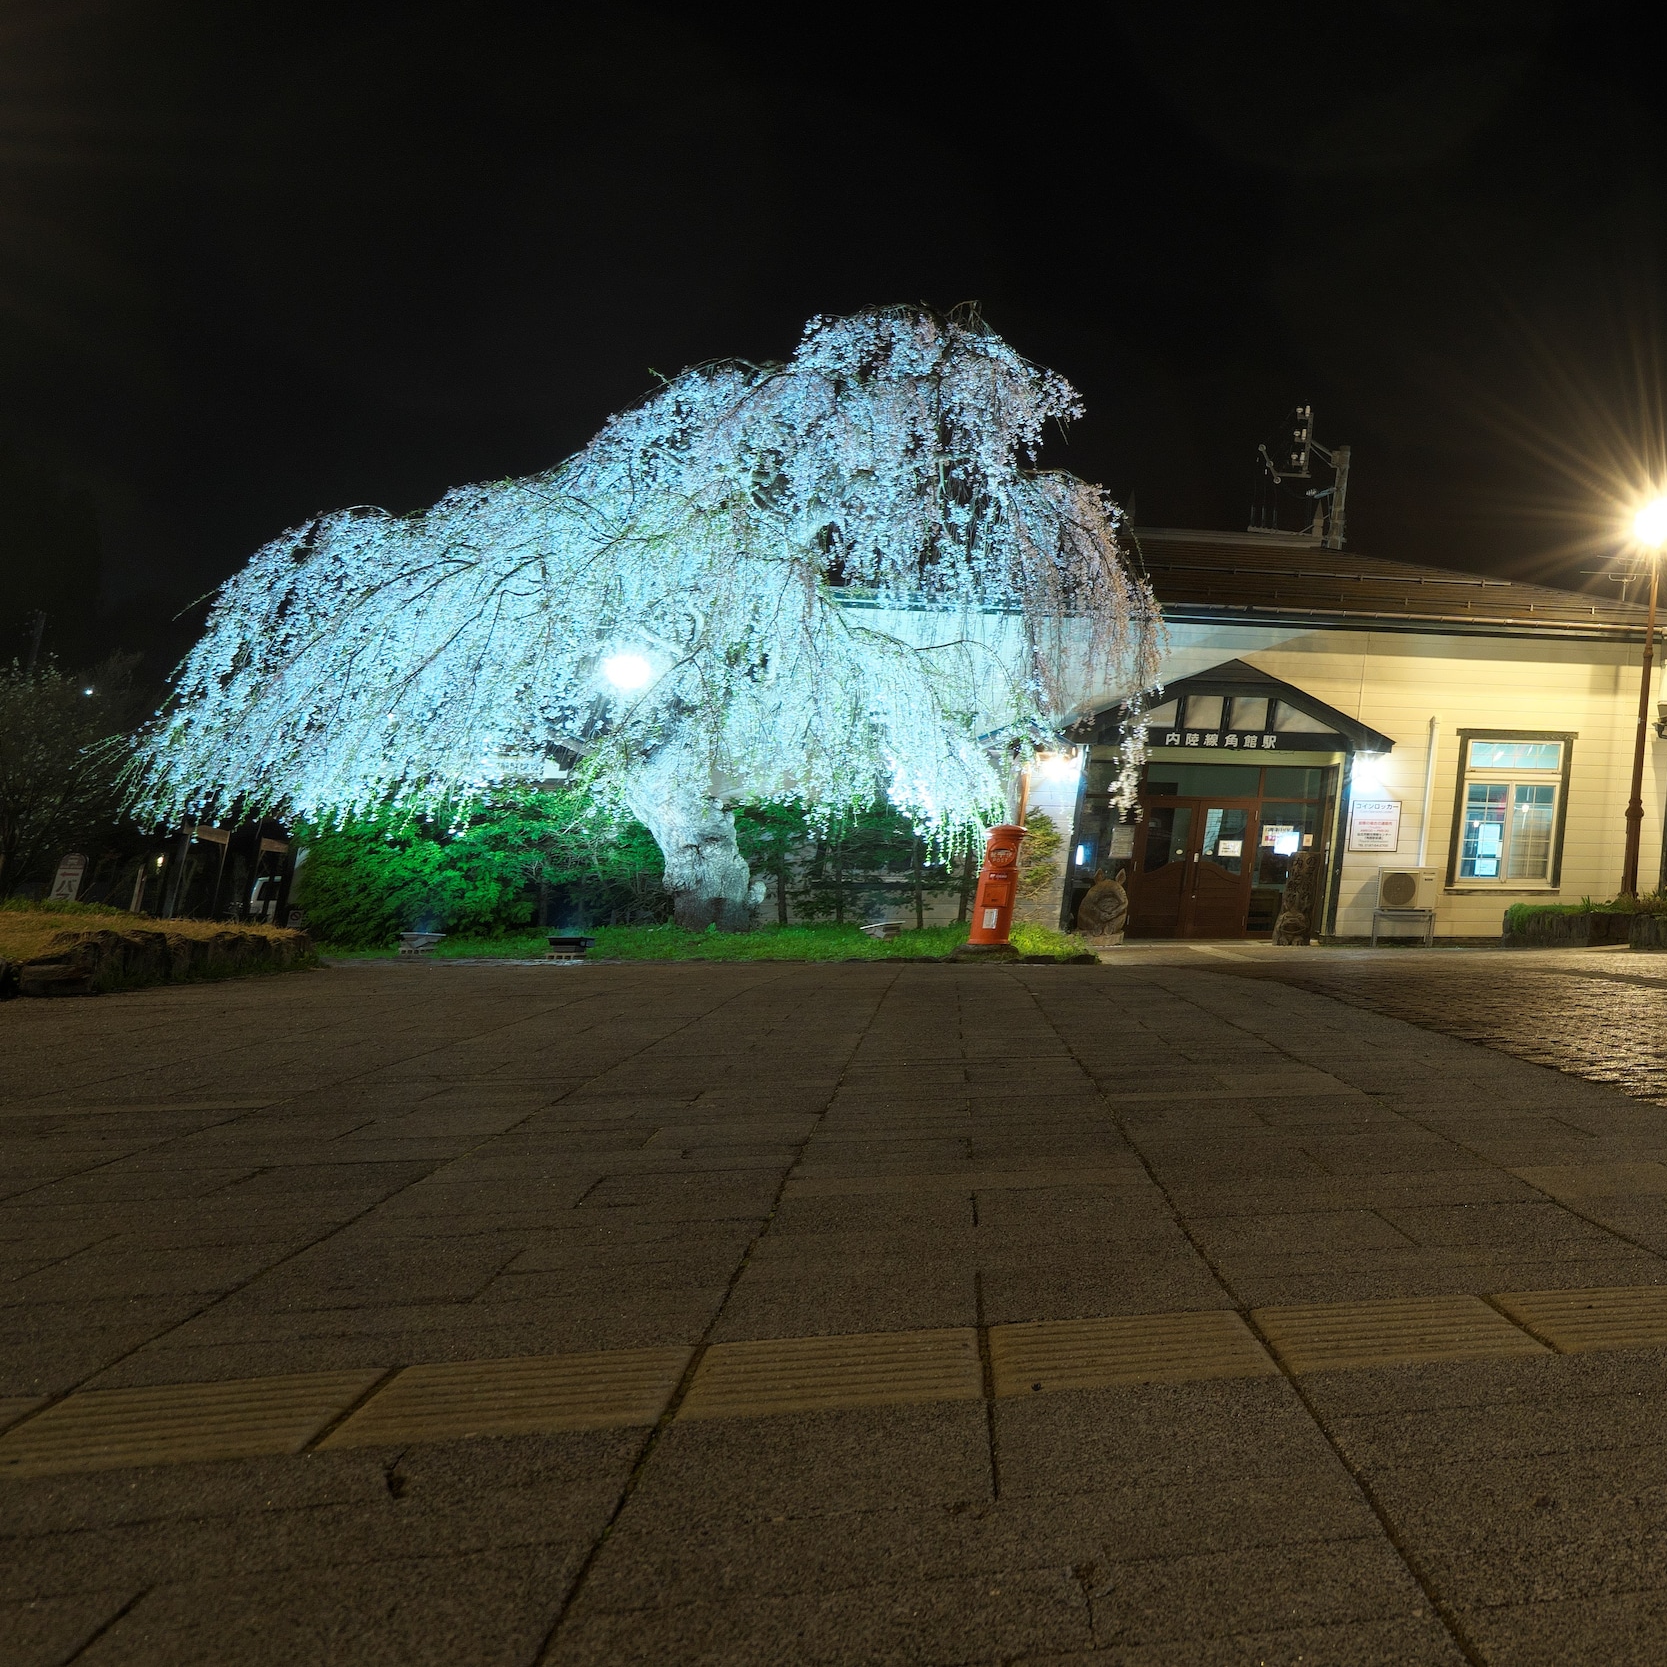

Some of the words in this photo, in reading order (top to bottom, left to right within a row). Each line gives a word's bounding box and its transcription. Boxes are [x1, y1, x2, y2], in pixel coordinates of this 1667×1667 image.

[1165, 733, 1277, 749] 内陸線角館駅
